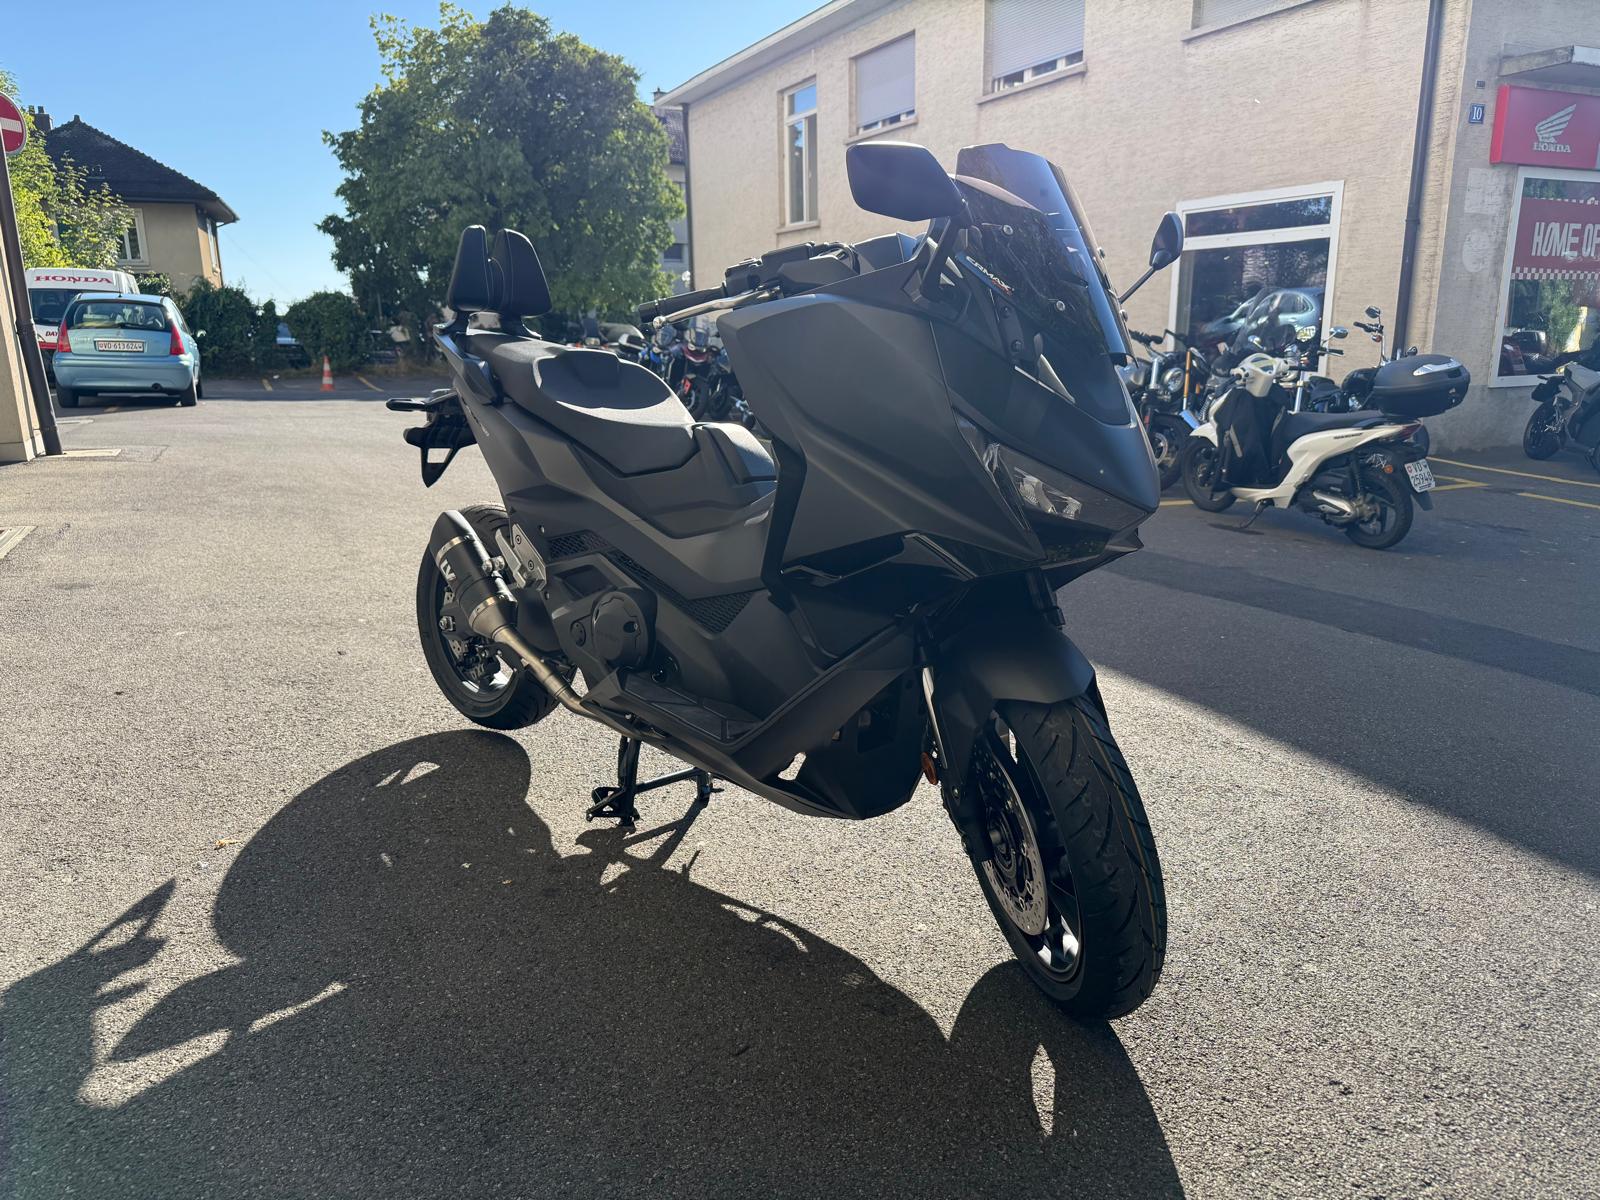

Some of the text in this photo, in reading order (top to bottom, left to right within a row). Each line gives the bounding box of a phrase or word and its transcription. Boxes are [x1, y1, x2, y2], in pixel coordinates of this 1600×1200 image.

[1472, 106, 1482, 120] 10
[1533, 142, 1572, 153] HONDA
[34, 275, 113, 284] HONDA
